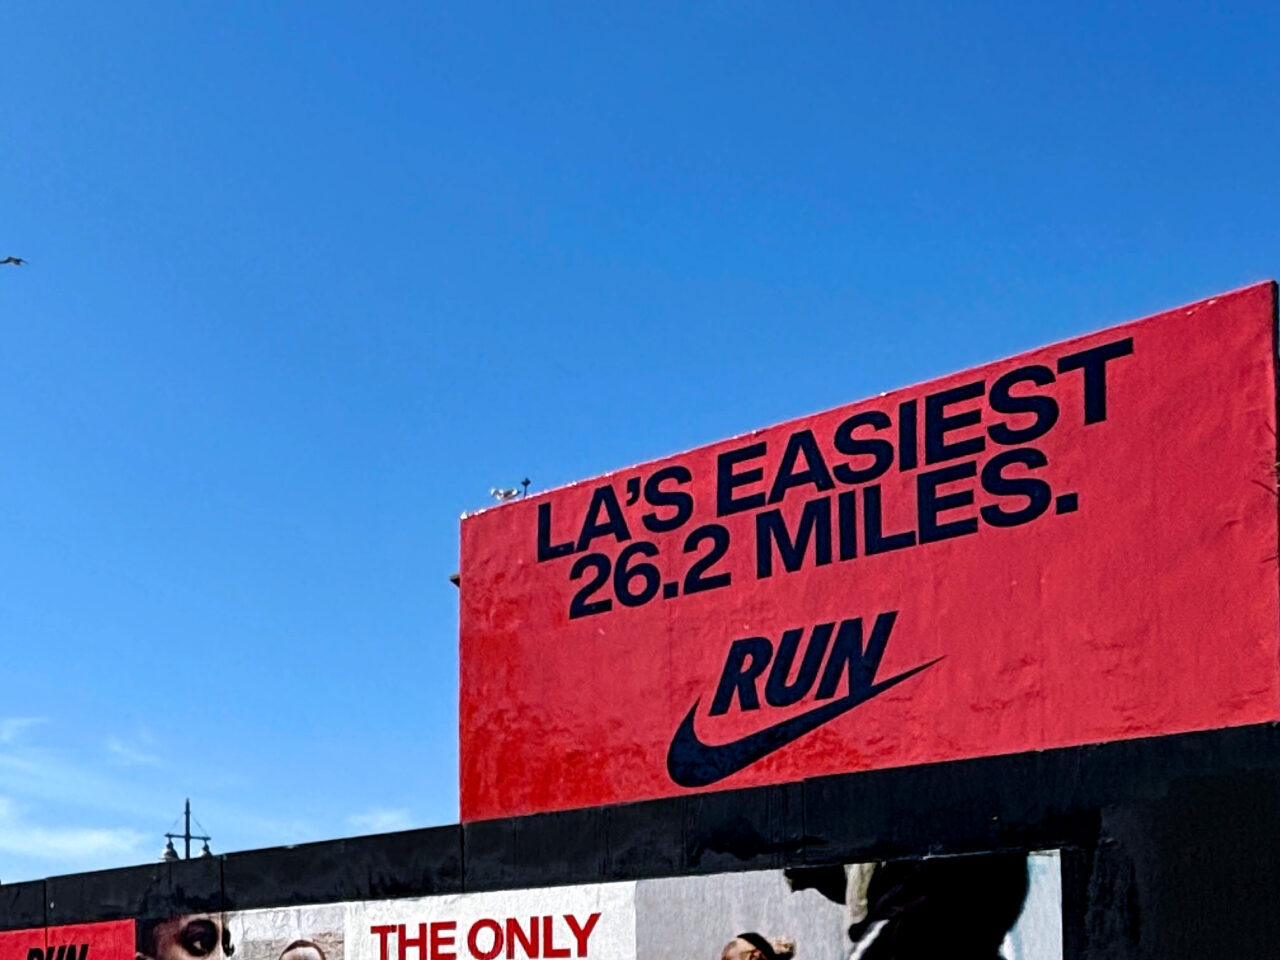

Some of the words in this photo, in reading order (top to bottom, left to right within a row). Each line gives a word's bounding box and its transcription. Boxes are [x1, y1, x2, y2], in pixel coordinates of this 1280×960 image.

[536, 466, 693, 562] LA'S
[715, 338, 1133, 518] EASIEST
[569, 524, 731, 619] 26.2
[756, 447, 1078, 579] MILES.
[709, 611, 898, 716] RUN
[467, 913, 601, 960] ONLY
